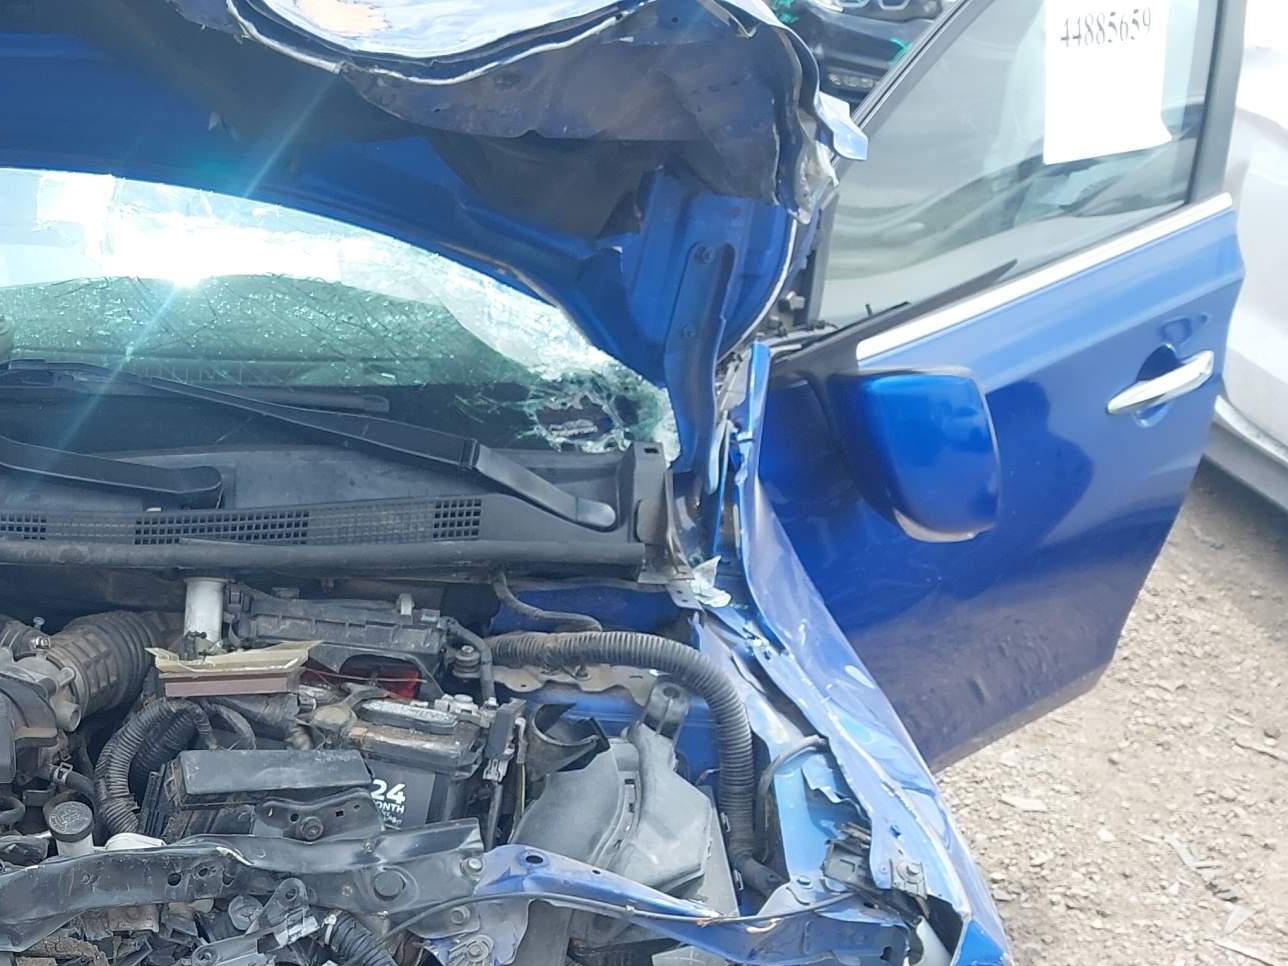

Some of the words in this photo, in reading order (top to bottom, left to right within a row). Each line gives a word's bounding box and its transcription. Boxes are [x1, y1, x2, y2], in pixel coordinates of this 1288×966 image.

[1060, 7, 1152, 47] 44885659
[372, 779, 406, 804] 24
[375, 801, 405, 815] ONTH
